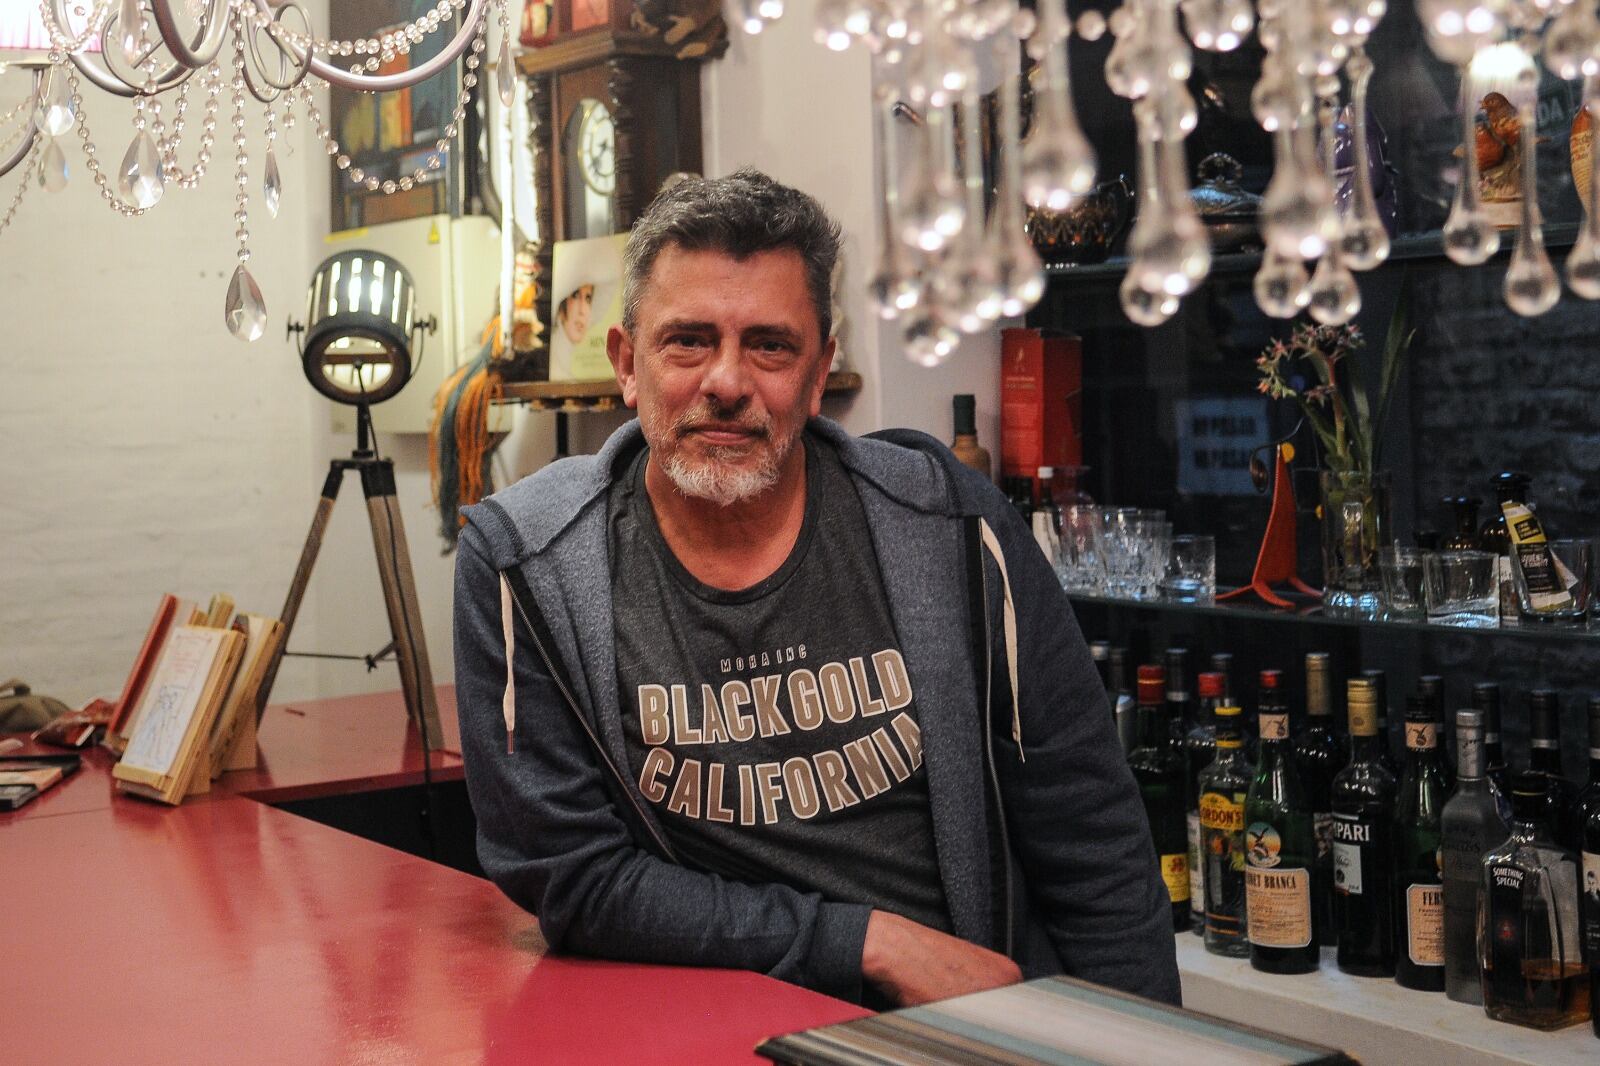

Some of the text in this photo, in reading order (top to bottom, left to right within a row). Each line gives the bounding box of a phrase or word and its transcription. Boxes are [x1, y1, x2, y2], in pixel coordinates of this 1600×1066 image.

[638, 711, 924, 826] CALIFORNIA
[1492, 867, 1524, 881] SOMETHING
[1496, 876, 1520, 889] SPECIAL
